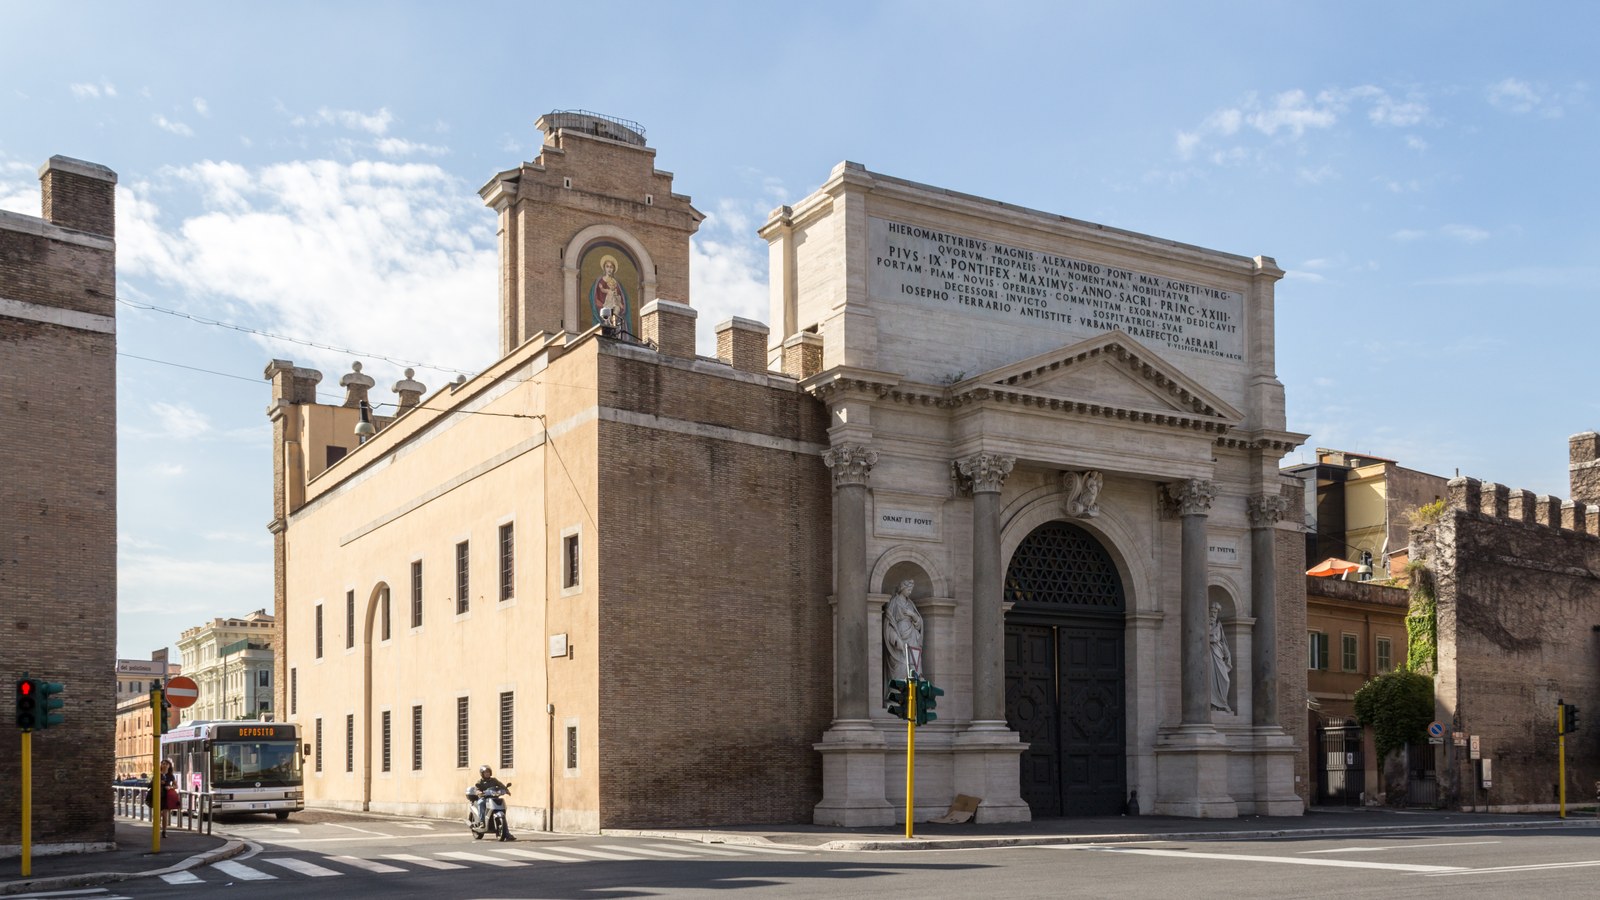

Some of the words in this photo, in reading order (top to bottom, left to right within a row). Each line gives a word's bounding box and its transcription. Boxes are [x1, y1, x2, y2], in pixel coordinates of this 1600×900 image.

[889, 223, 987, 251] HIEROMARTYRIBVS
[994, 245, 1034, 261] MAGNIS
[1042, 256, 1100, 275] ALEXANDRO
[1107, 268, 1133, 281] PONT
[1140, 275, 1160, 287] MAX
[1166, 281, 1200, 295] AGNETI
[1204, 288, 1228, 301] VIRG
[889, 246, 919, 262] PIVS
[929, 254, 941, 266] IX
[951, 258, 1010, 280] PONTIFEX
[1019, 272, 1074, 292] MAXIMVS
[1081, 285, 1112, 299] ANNO
[1119, 293, 1151, 307] SACRI
[1161, 300, 1195, 315] PRINC
[1201, 308, 1227, 322] XXIII
[938, 245, 983, 262] QVORVM
[992, 255, 1036, 272] TROPAEIS
[1044, 266, 1060, 277] VIA
[1068, 271, 1124, 290] NOMENTANA
[1132, 284, 1190, 303] NOBILITATVR
[876, 257, 922, 274] PORTAM
[930, 268, 954, 280] PIAM
[964, 274, 994, 287] NOVIS
[1002, 282, 1047, 298] OPERIBVS
[1056, 293, 1121, 312] COMMVNITAM
[1129, 307, 1181, 323] EXORNATAM
[1186, 317, 1236, 334] DEDICAVIT
[901, 284, 949, 301] IOSEPHO
[958, 295, 1011, 312] FERRARIO
[1020, 307, 1072, 324] ANTISTITE
[1127, 326, 1179, 343] PRAEFECTO
[944, 281, 998, 299] DECESSORI
[1006, 293, 1048, 308] INVICTO
[1093, 310, 1155, 328] SOSPITATRICI
[1162, 322, 1183, 333] SVAE
[882, 515, 903, 523] ORNAT
[914, 518, 932, 526] FOVET
[239, 727, 275, 737] DEPOSITO
